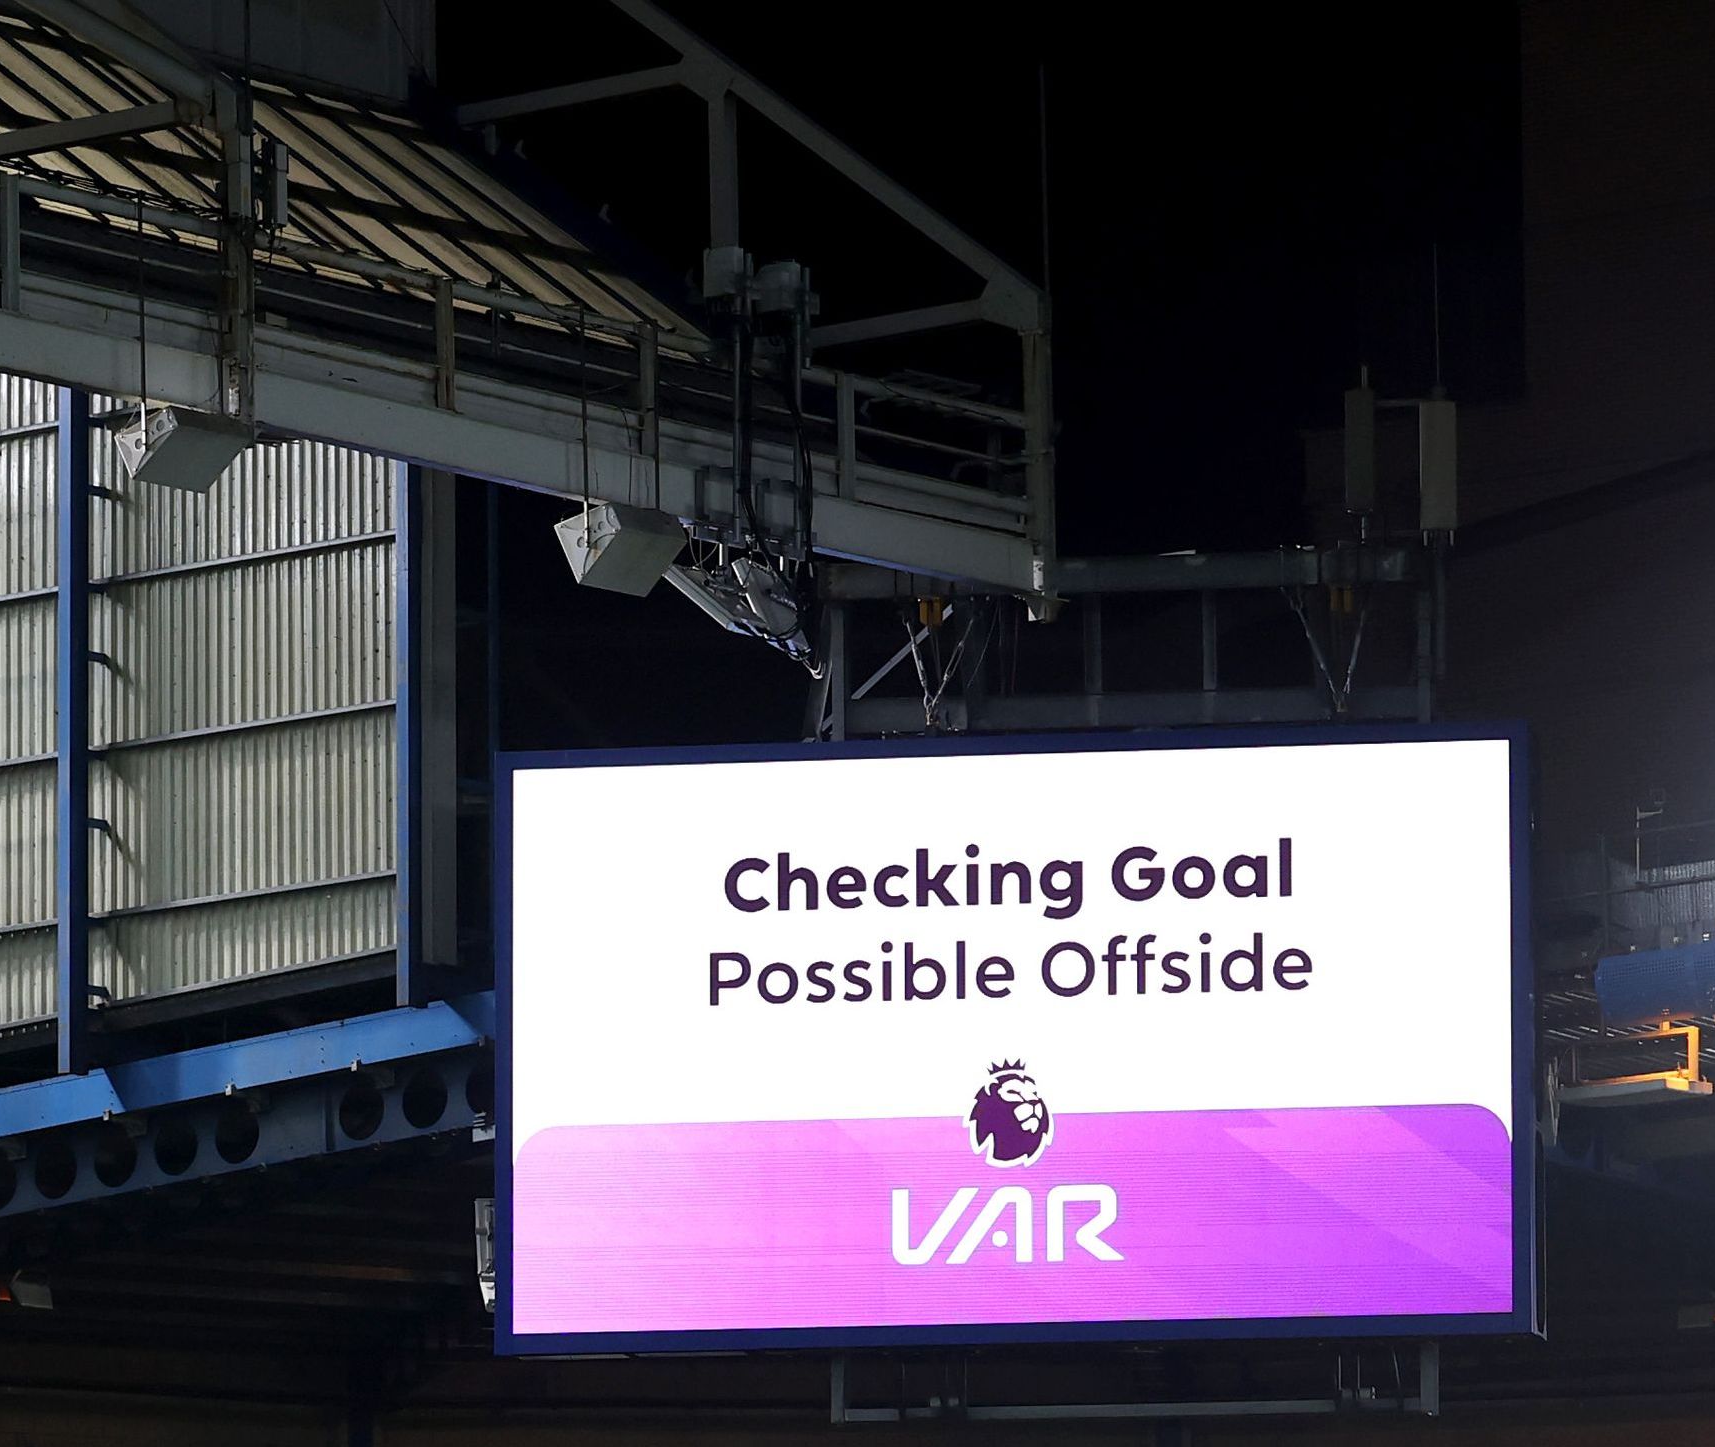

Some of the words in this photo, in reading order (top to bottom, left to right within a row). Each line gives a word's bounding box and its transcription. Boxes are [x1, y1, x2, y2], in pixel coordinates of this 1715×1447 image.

[724, 844, 1084, 919] Checking
[1111, 838, 1294, 902] Goal
[709, 941, 1017, 1006] Possible
[1041, 932, 1314, 997] Offside
[892, 1184, 1125, 1266] VAR
